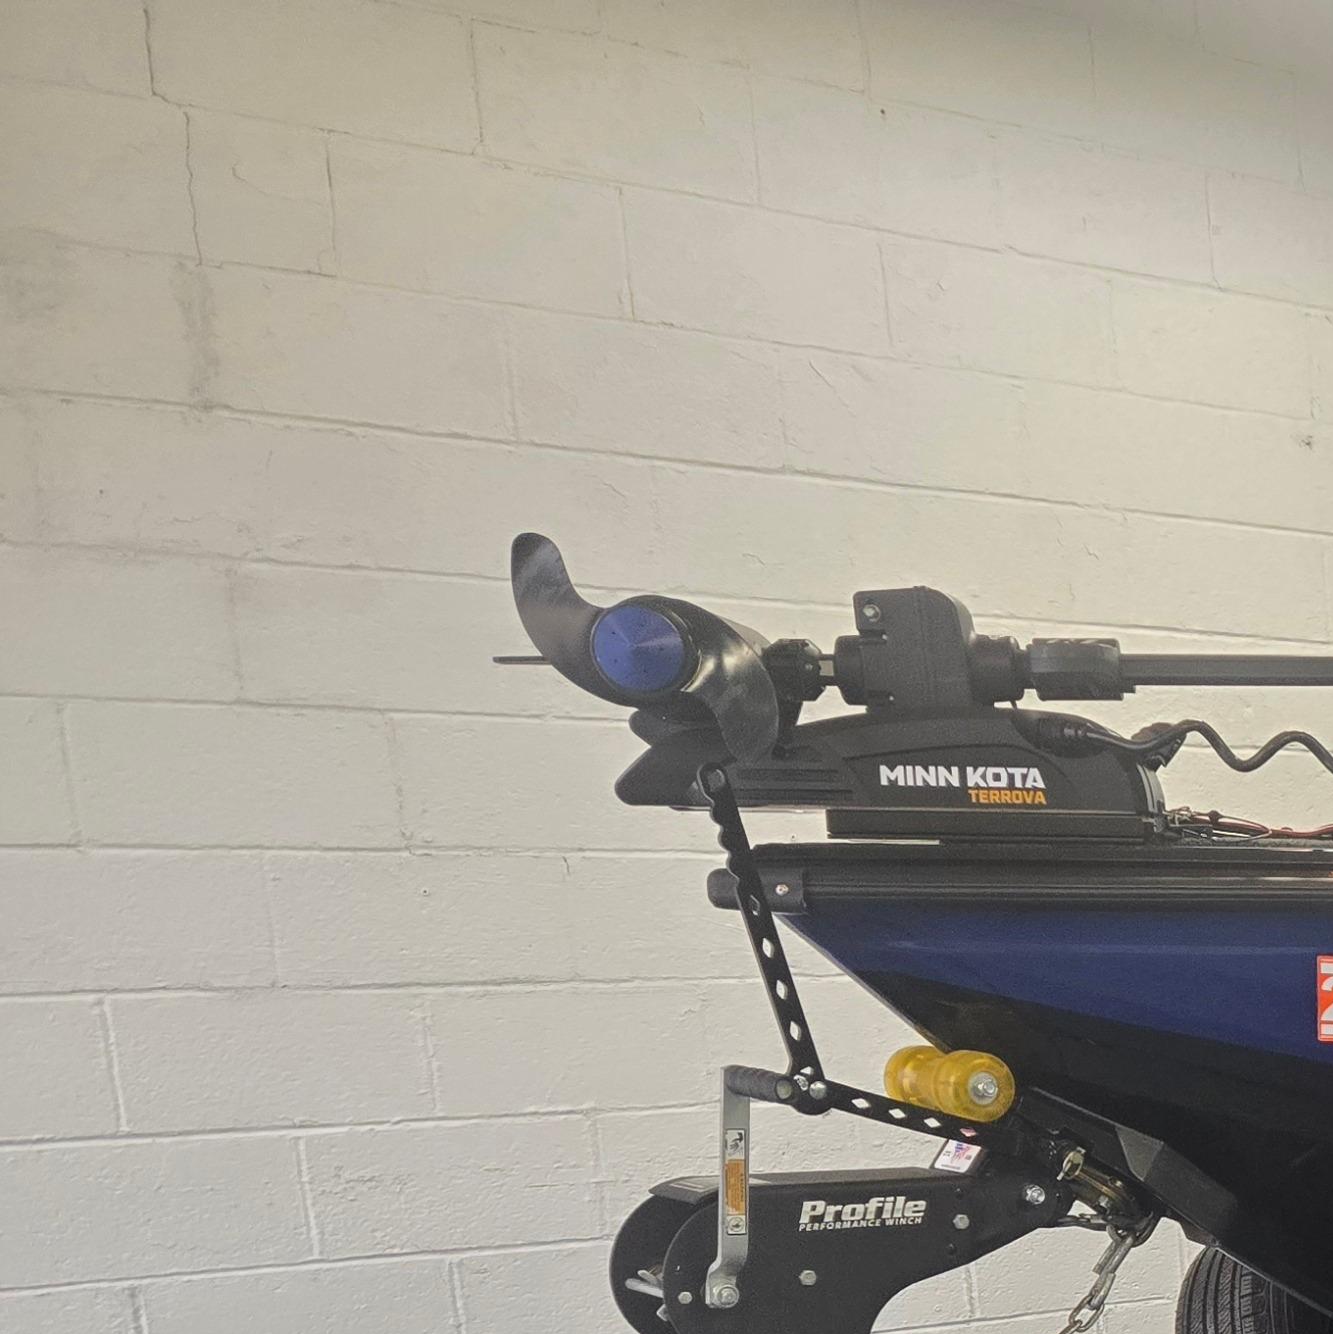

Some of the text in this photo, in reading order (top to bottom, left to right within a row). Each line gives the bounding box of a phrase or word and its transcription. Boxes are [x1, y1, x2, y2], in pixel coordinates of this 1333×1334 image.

[879, 765, 1046, 789] MINN KOTA
[968, 790, 1047, 804] TERROVA
[799, 1196, 927, 1224] Profile
[799, 1217, 922, 1231] PERFORMANCE WINCH
